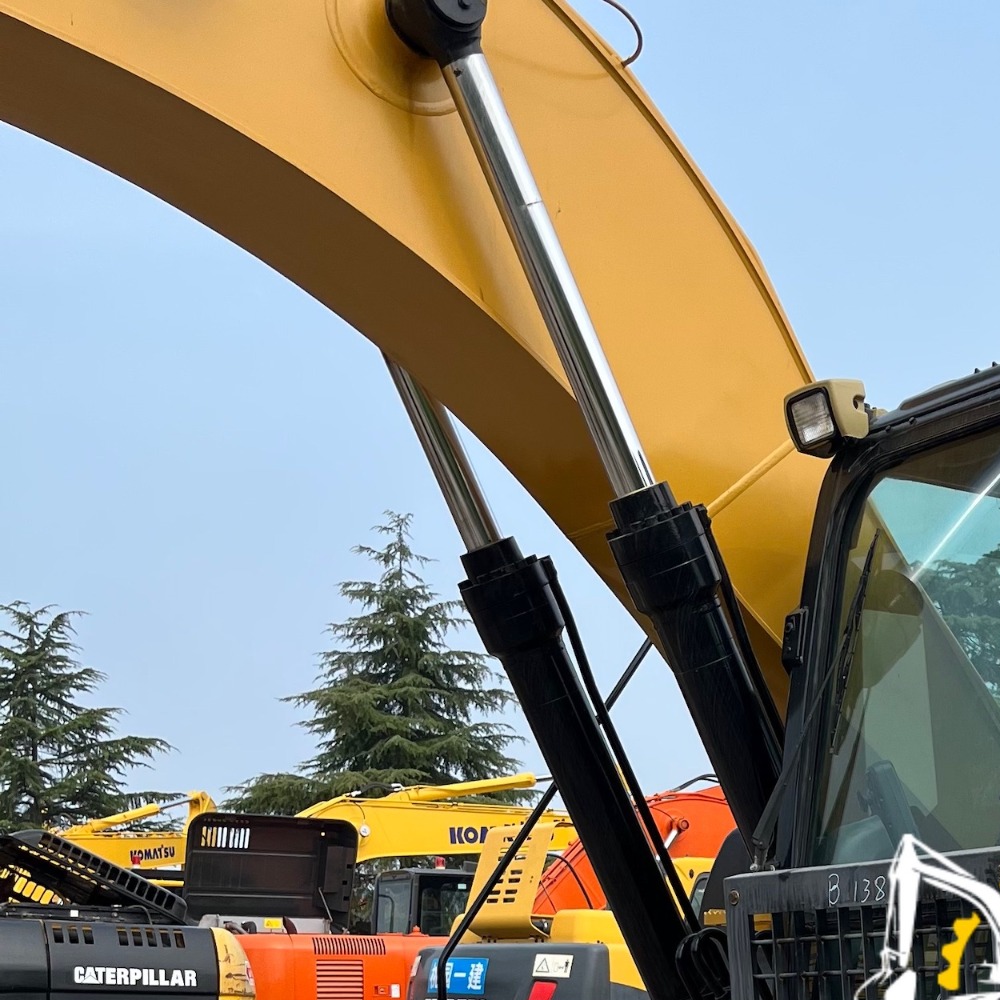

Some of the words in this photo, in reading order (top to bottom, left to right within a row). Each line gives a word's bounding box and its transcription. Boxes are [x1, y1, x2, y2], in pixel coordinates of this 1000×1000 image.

[828, 873, 840, 907] B
[853, 875, 886, 903] 138
[74, 966, 197, 987] CATERPILLAR
